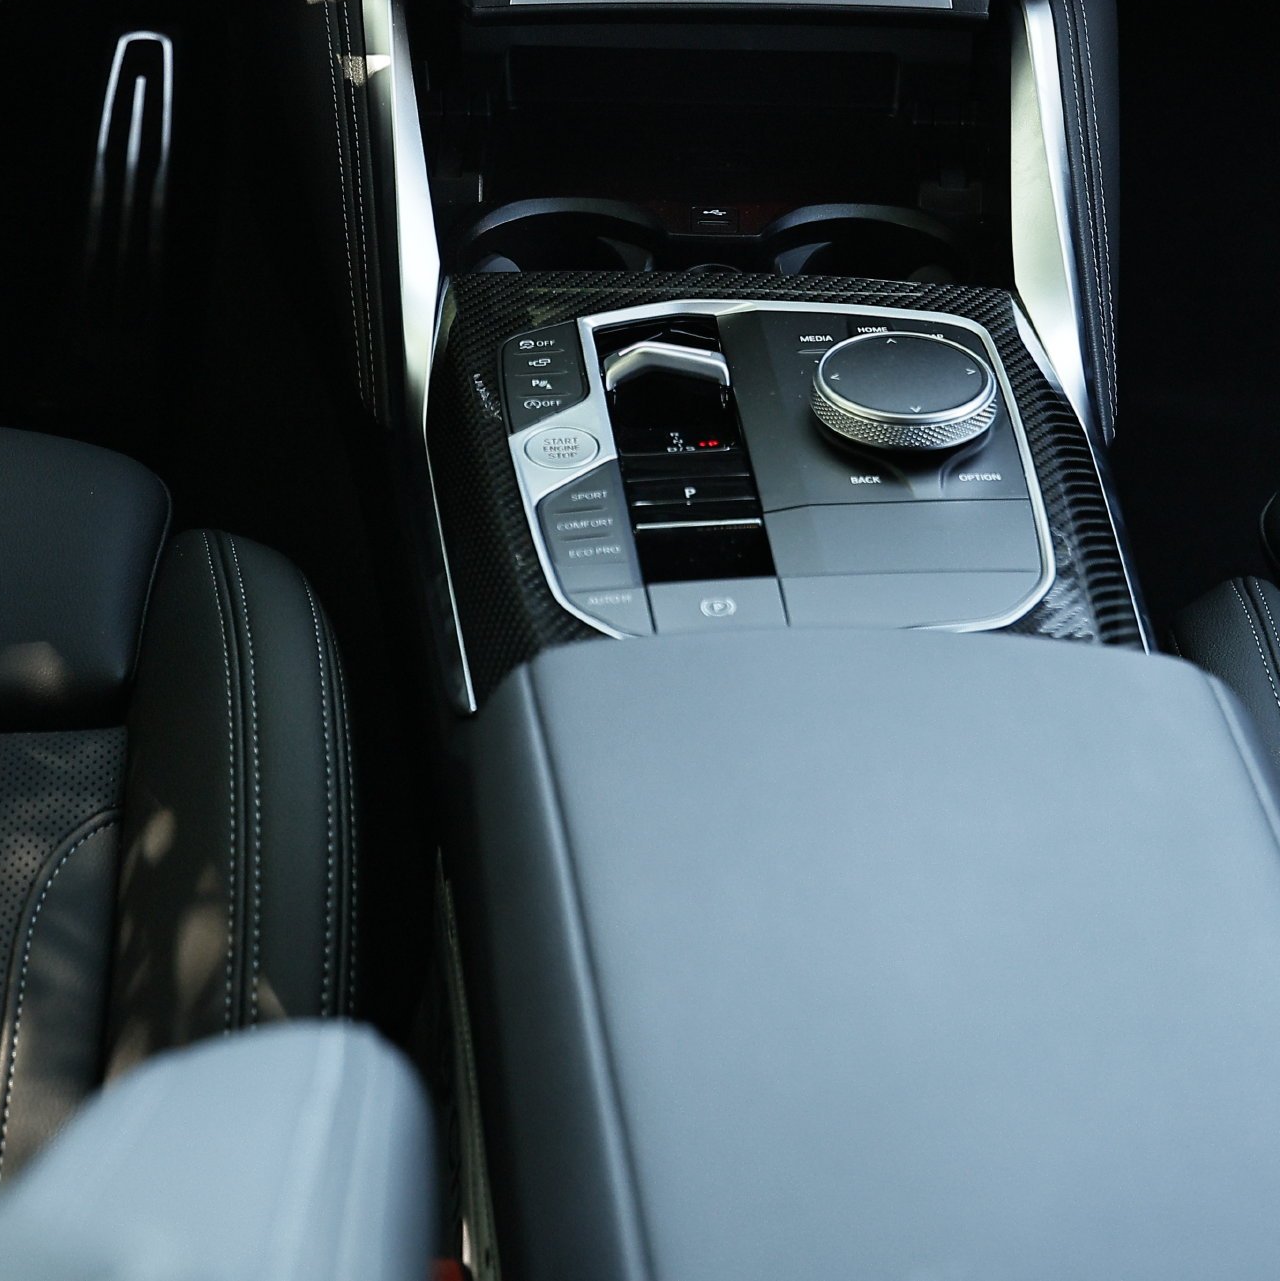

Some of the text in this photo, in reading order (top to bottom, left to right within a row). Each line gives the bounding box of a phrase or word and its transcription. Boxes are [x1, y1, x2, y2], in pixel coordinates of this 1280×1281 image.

[544, 437, 578, 445] START
[850, 475, 882, 484] BACK
[959, 472, 1002, 481] OPTION
[571, 491, 608, 502] SPORT
[684, 486, 696, 499] P
[557, 518, 614, 531] COMFORT
[569, 546, 621, 558] ECO PRO
